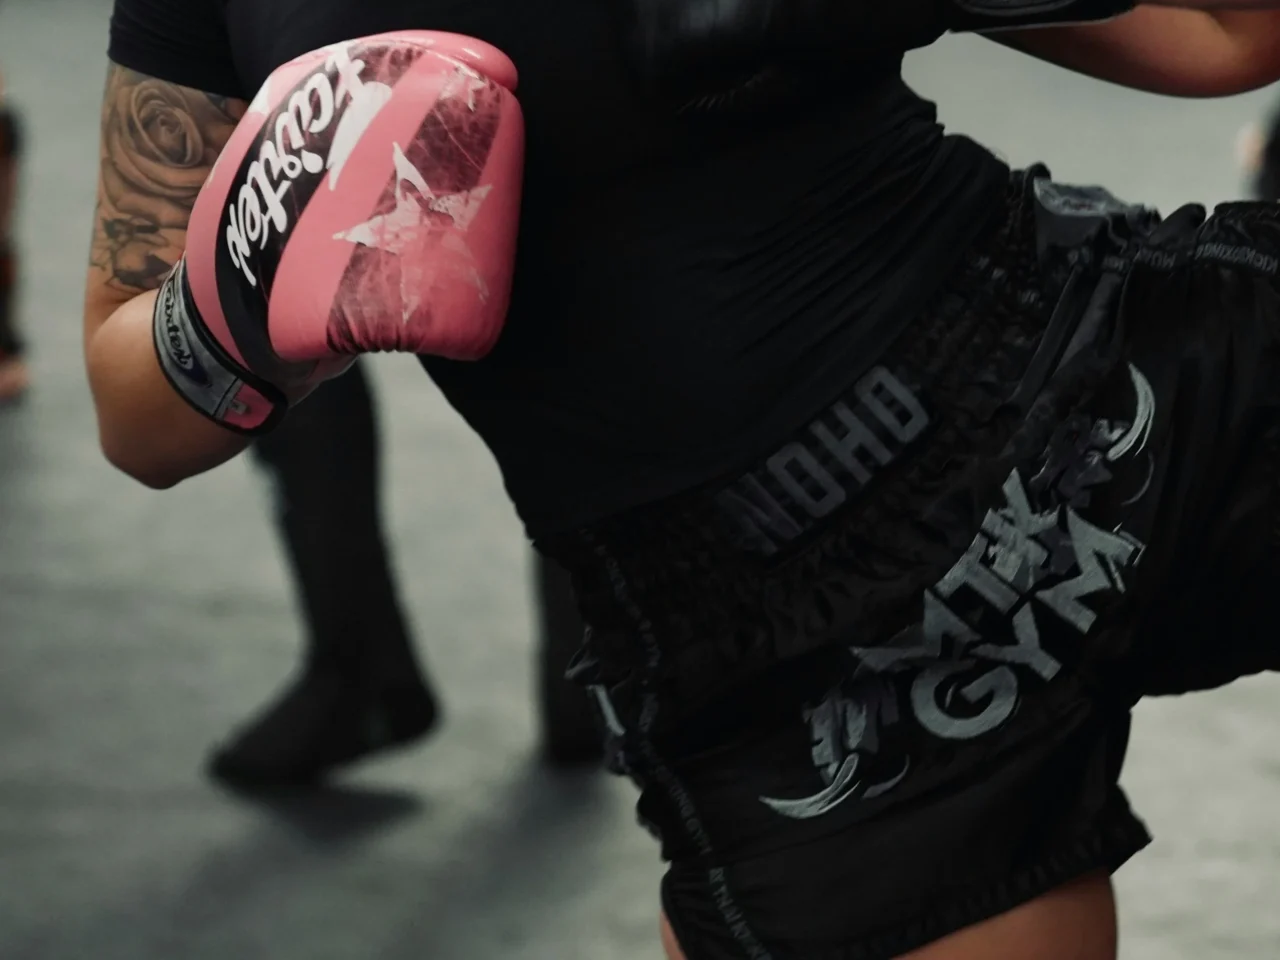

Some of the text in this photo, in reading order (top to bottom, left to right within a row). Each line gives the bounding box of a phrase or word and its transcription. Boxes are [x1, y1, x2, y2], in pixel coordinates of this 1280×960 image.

[226, 43, 393, 287] Fairtex
[714, 364, 931, 557] NOHO
[911, 505, 1148, 741] GYM
